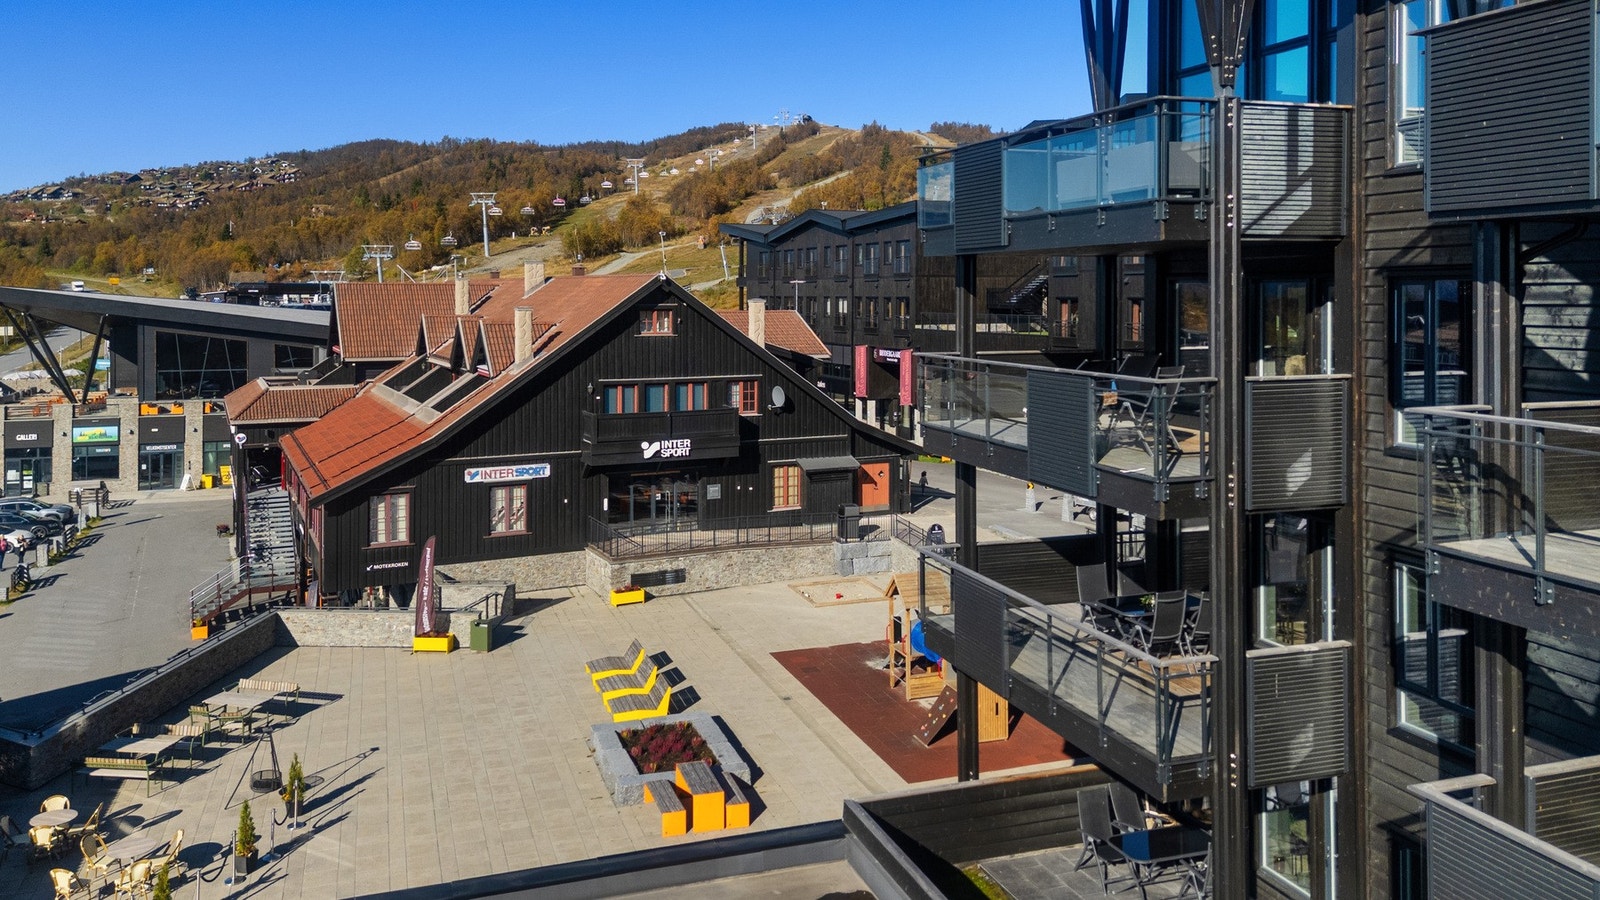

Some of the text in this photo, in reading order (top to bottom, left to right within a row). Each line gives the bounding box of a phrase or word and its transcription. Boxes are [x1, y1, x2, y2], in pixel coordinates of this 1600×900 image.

[661, 439, 691, 449] INTER
[660, 448, 691, 458] SPORT
[373, 561, 409, 569] MOTEKROKEN
